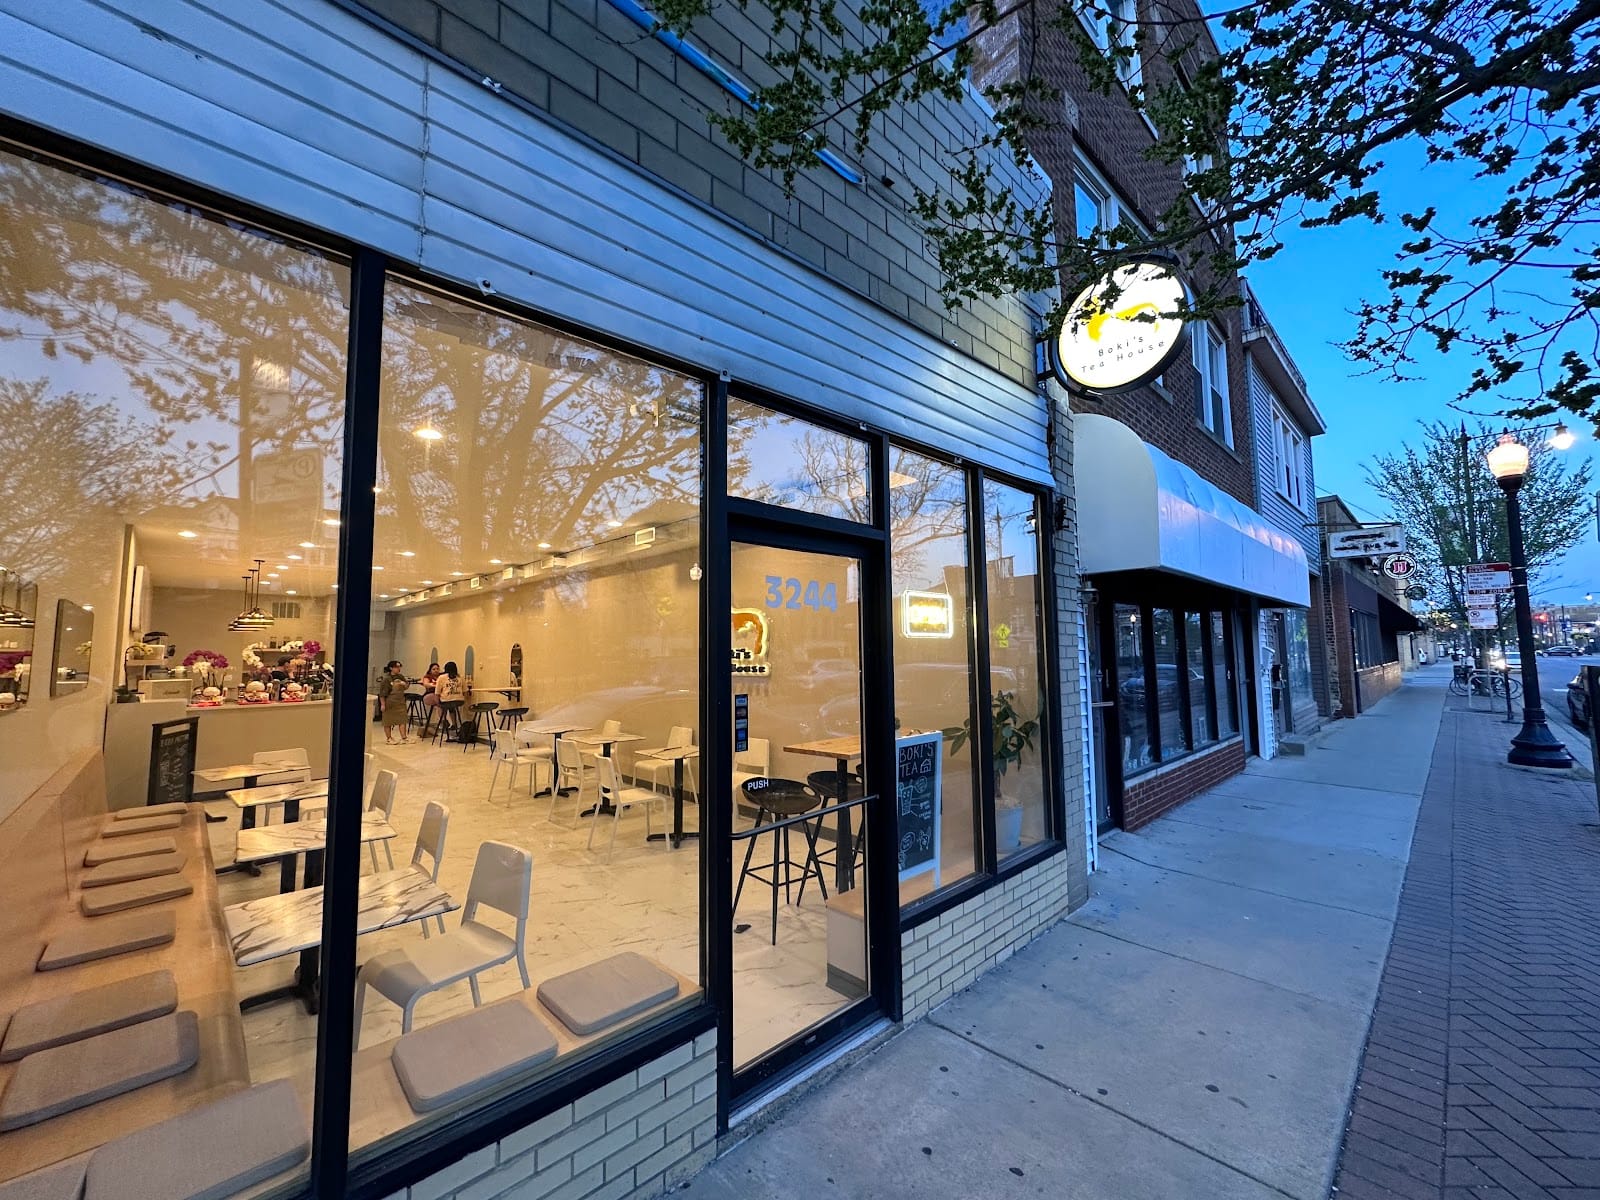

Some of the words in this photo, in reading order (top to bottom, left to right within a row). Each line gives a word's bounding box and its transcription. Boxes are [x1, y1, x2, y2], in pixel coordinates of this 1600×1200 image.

[1081, 361, 1105, 373] Tea
[1117, 341, 1164, 361] House
[765, 576, 838, 612] 3244
[900, 742, 934, 763] BOKI'S
[900, 761, 918, 778] TEA
[748, 779, 768, 791] PUSH
